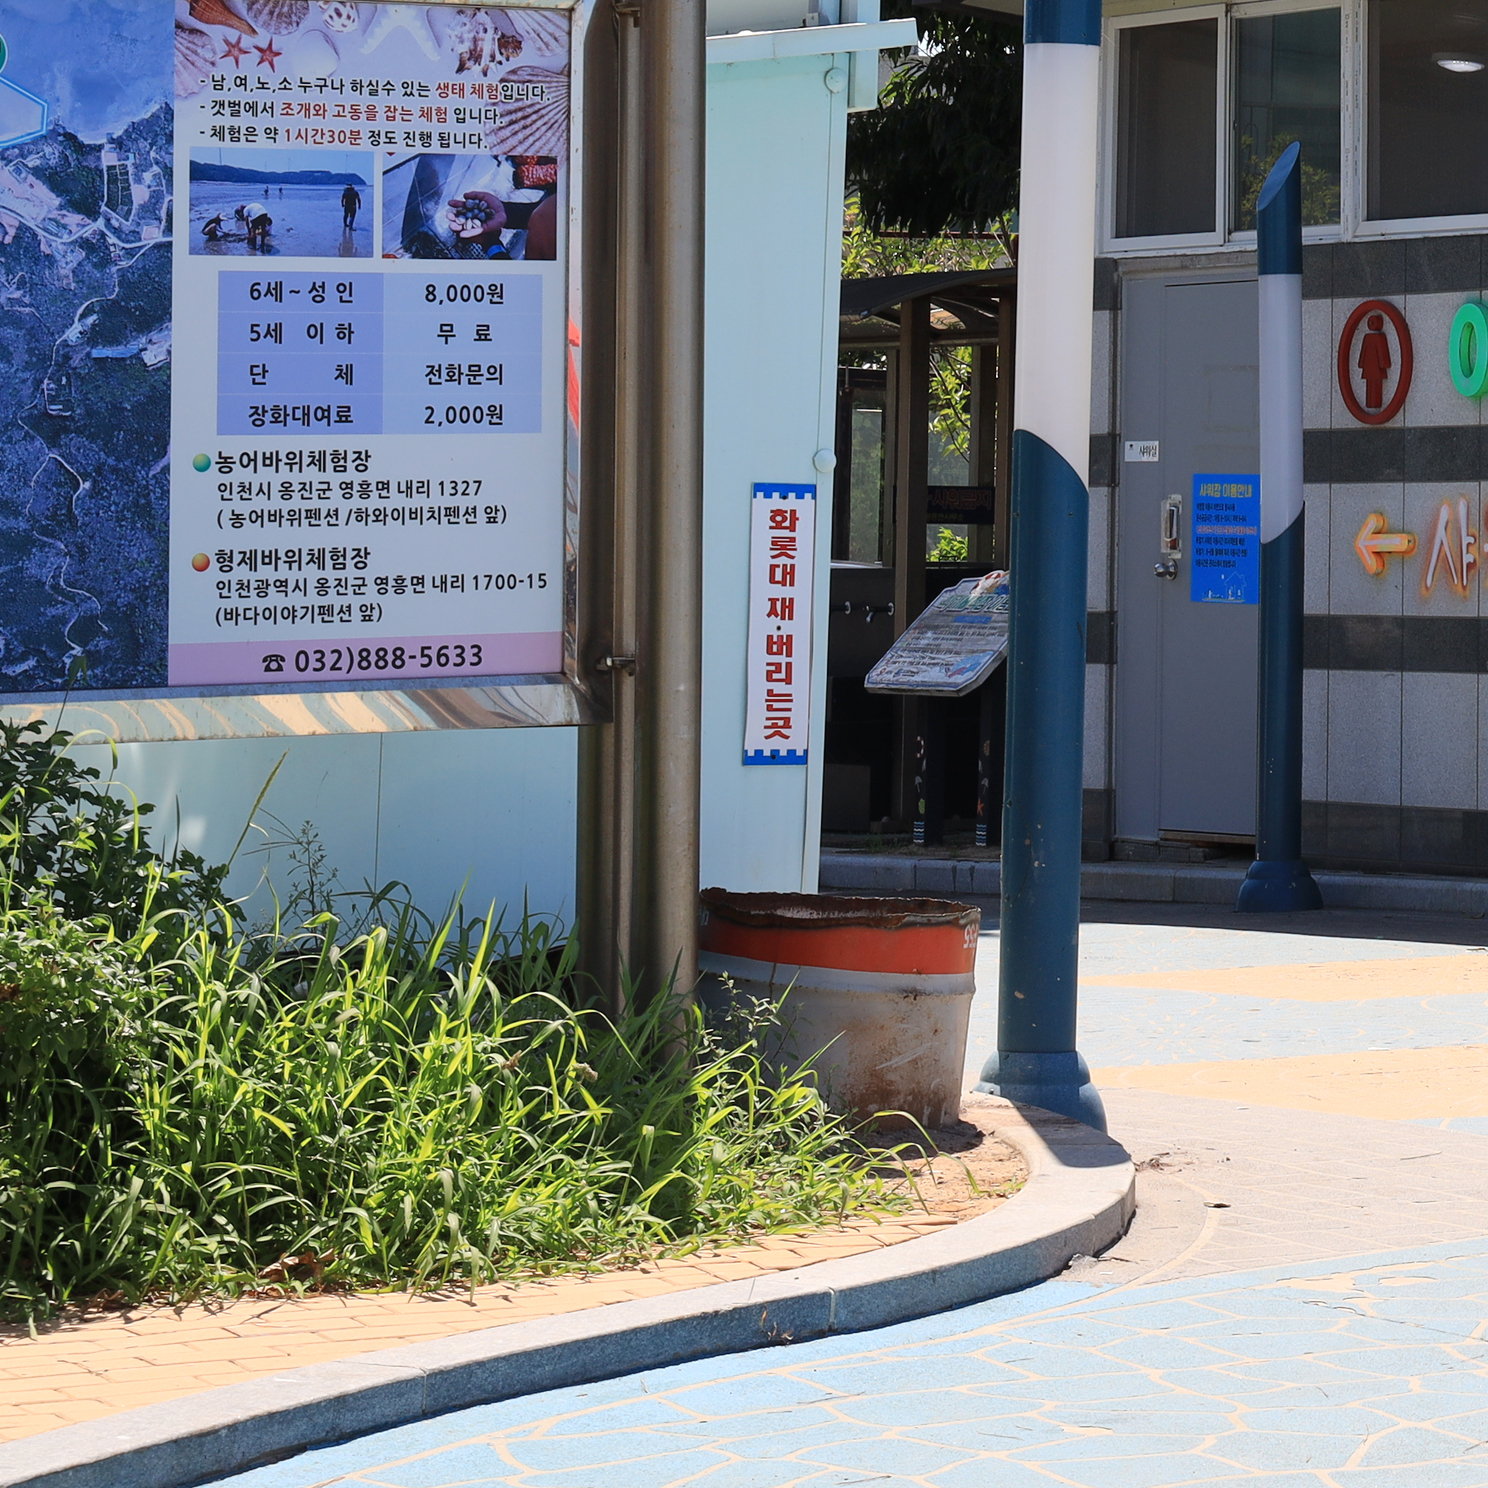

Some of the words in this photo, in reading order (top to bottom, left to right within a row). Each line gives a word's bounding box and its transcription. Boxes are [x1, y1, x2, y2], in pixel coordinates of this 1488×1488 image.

[210, 74, 293, 93] 남,여,노,소
[298, 77, 345, 95] 누구나
[350, 78, 396, 96] 하실수
[401, 80, 431, 97] 있는
[435, 82, 465, 99] 생태
[210, 99, 275, 118] 갯벌에서
[280, 102, 328, 119] 조개와
[332, 103, 379, 121] 고동을
[383, 104, 414, 122] 잡는
[418, 106, 448, 123] 체험
[454, 107, 503, 125] 입니다.
[210, 125, 259, 143] 체험은
[263, 126, 279, 143] 약
[284, 128, 363, 145] 1시간30분
[368, 129, 398, 146] 정도
[402, 130, 432, 148] 진행
[437, 132, 488, 149] 됩니다.
[424, 283, 505, 305] 8,000원
[250, 322, 283, 344] 5세
[424, 363, 503, 386] 전화문의
[248, 404, 354, 427] 장화대여료
[424, 404, 504, 427] 2,000원
[214, 449, 372, 474] 농어바위체험장
[217, 481, 271, 501] 인천시
[278, 481, 333, 501] 옹진군
[339, 480, 390, 500] 영흥면
[397, 479, 430, 499] 내리
[438, 480, 482, 497] 1327
[484, 504, 507, 525] 앞)
[214, 547, 371, 573] 형제바위체험장
[768, 508, 799, 587] 화롯대
[216, 577, 307, 599] 인천광역시
[314, 576, 368, 597] 옹진군
[374, 574, 425, 596] 영흥면
[432, 574, 465, 593] 내리
[472, 573, 547, 590] 1700-15
[215, 602, 353, 627] (바다이야기펜션
[359, 601, 383, 623] 앞)
[766, 596, 795, 621] 재
[294, 643, 483, 674] 032)888-5633
[763, 634, 794, 741] 버리는곳
